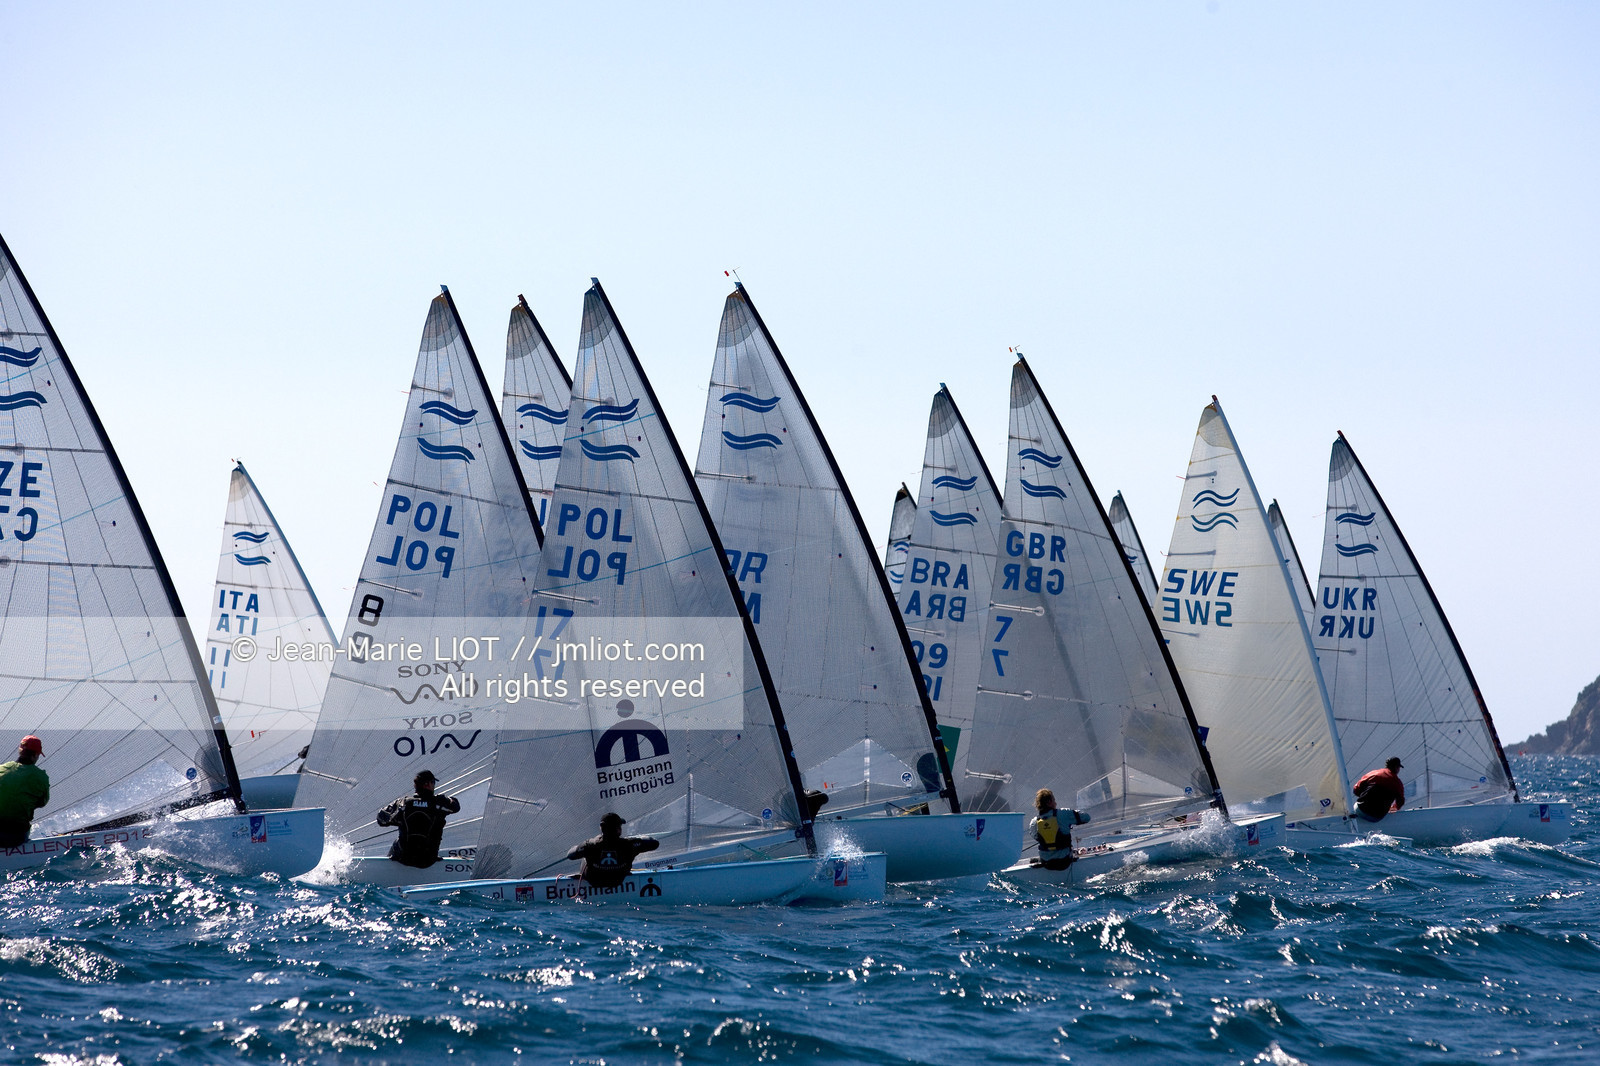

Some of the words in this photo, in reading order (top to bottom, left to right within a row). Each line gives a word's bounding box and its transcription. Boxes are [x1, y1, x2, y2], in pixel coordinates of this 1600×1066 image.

[386, 494, 460, 540] POL
[557, 503, 633, 543] POL
[1005, 530, 1067, 563] GBR
[910, 557, 969, 590] BRA
[1163, 568, 1239, 597] SWE
[218, 589, 260, 613] ITA
[357, 594, 385, 627] 8
[1323, 587, 1377, 611] UKR
[534, 605, 575, 640] 17
[993, 615, 1014, 643] 7
[210, 647, 231, 668] 11
[397, 660, 466, 679] SONY
[596, 760, 673, 784] Brügmann
